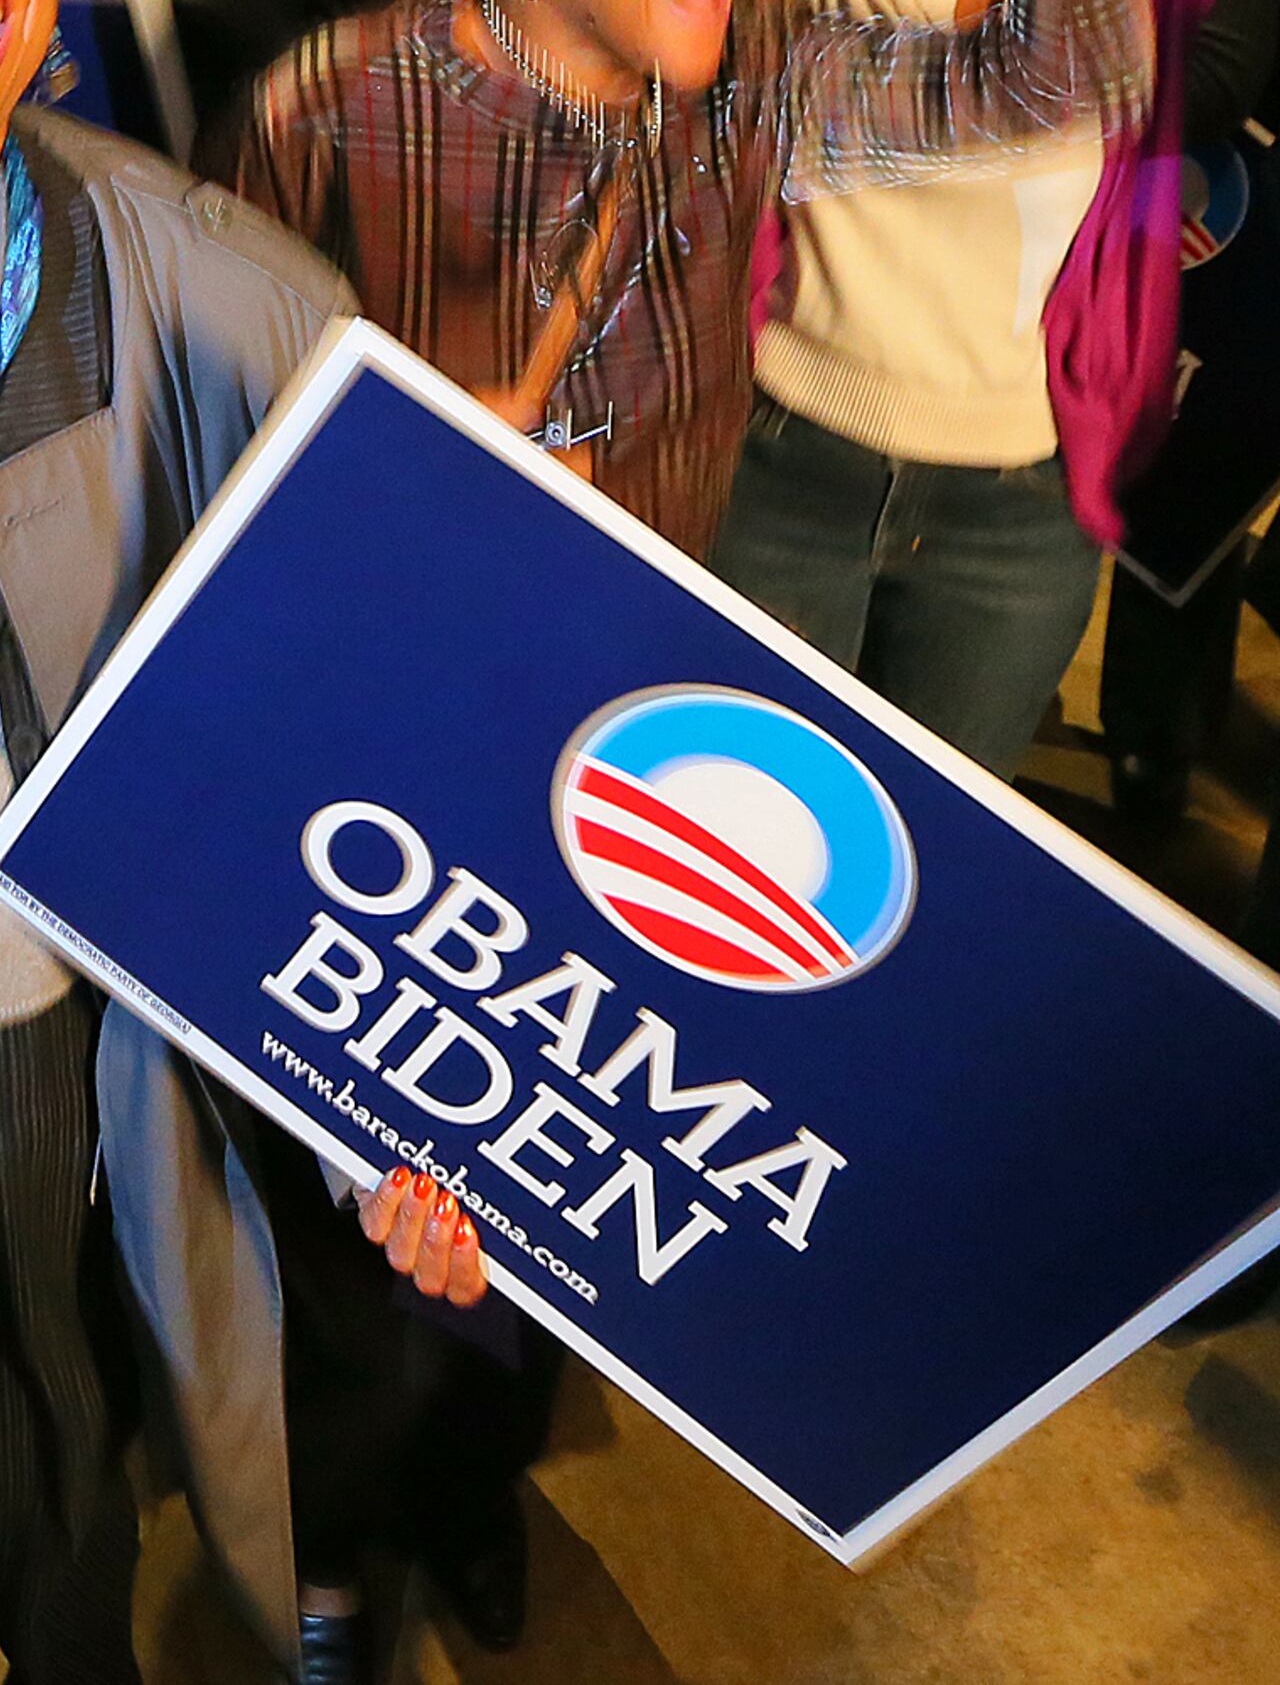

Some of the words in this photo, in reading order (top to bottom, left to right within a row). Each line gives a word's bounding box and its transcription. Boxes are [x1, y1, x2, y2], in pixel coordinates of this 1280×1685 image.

[259, 912, 728, 1288] BIDEN
[260, 1031, 599, 1304] www.barackobama.com
[301, 799, 848, 1252] OBAMA
